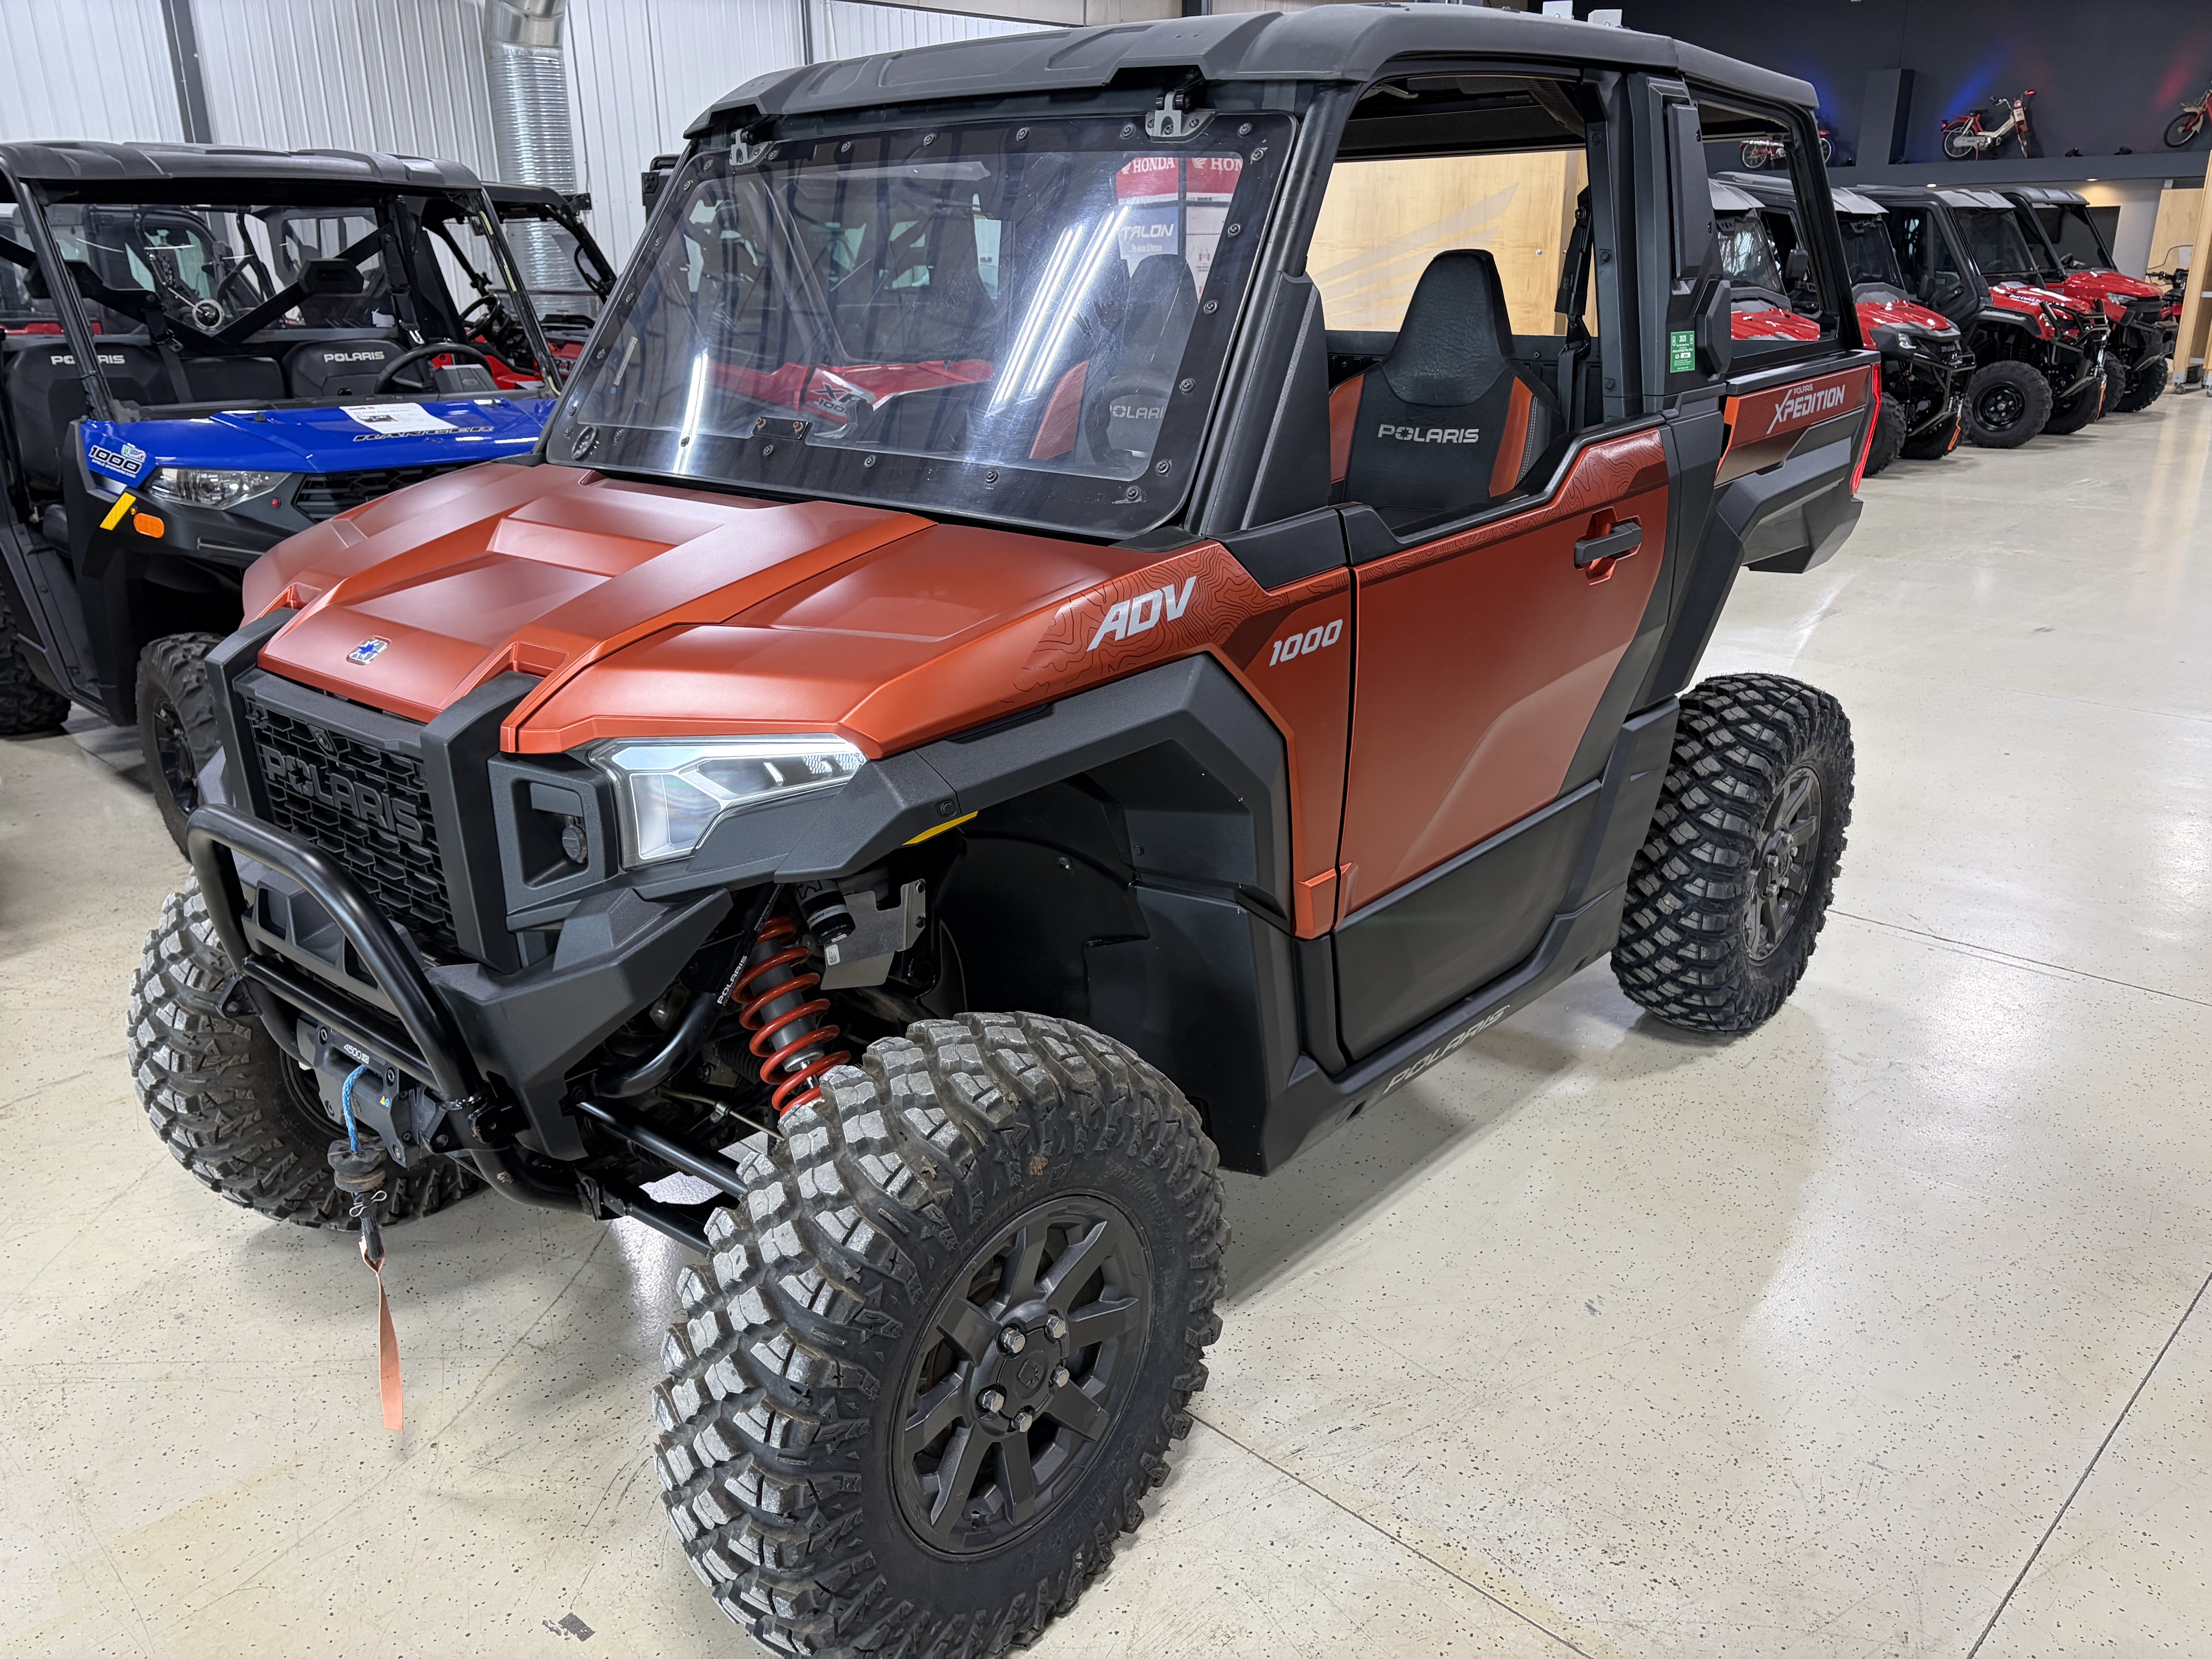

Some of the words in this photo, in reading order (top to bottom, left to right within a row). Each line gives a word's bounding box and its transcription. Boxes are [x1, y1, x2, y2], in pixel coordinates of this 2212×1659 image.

[1132, 157, 1175, 173] HONDA
[1121, 223, 1175, 241] TALON
[50, 355, 125, 365] PORIS
[323, 351, 385, 362] POLARIS
[1794, 384, 1813, 395] POLARIS
[818, 398, 847, 413] 100
[1110, 405, 1166, 419] OLARI
[1766, 384, 1845, 434] XPEDITION
[1378, 424, 1479, 443] POLARIS
[88, 445, 142, 474] 1000
[1086, 575, 1197, 651] ADV
[1269, 619, 1343, 666] 1000
[263, 745, 425, 844] POLARIS
[716, 955, 747, 1004] POLARIS
[343, 1044, 362, 1060] 4500
[1382, 1005, 1510, 1094] POLARIS
